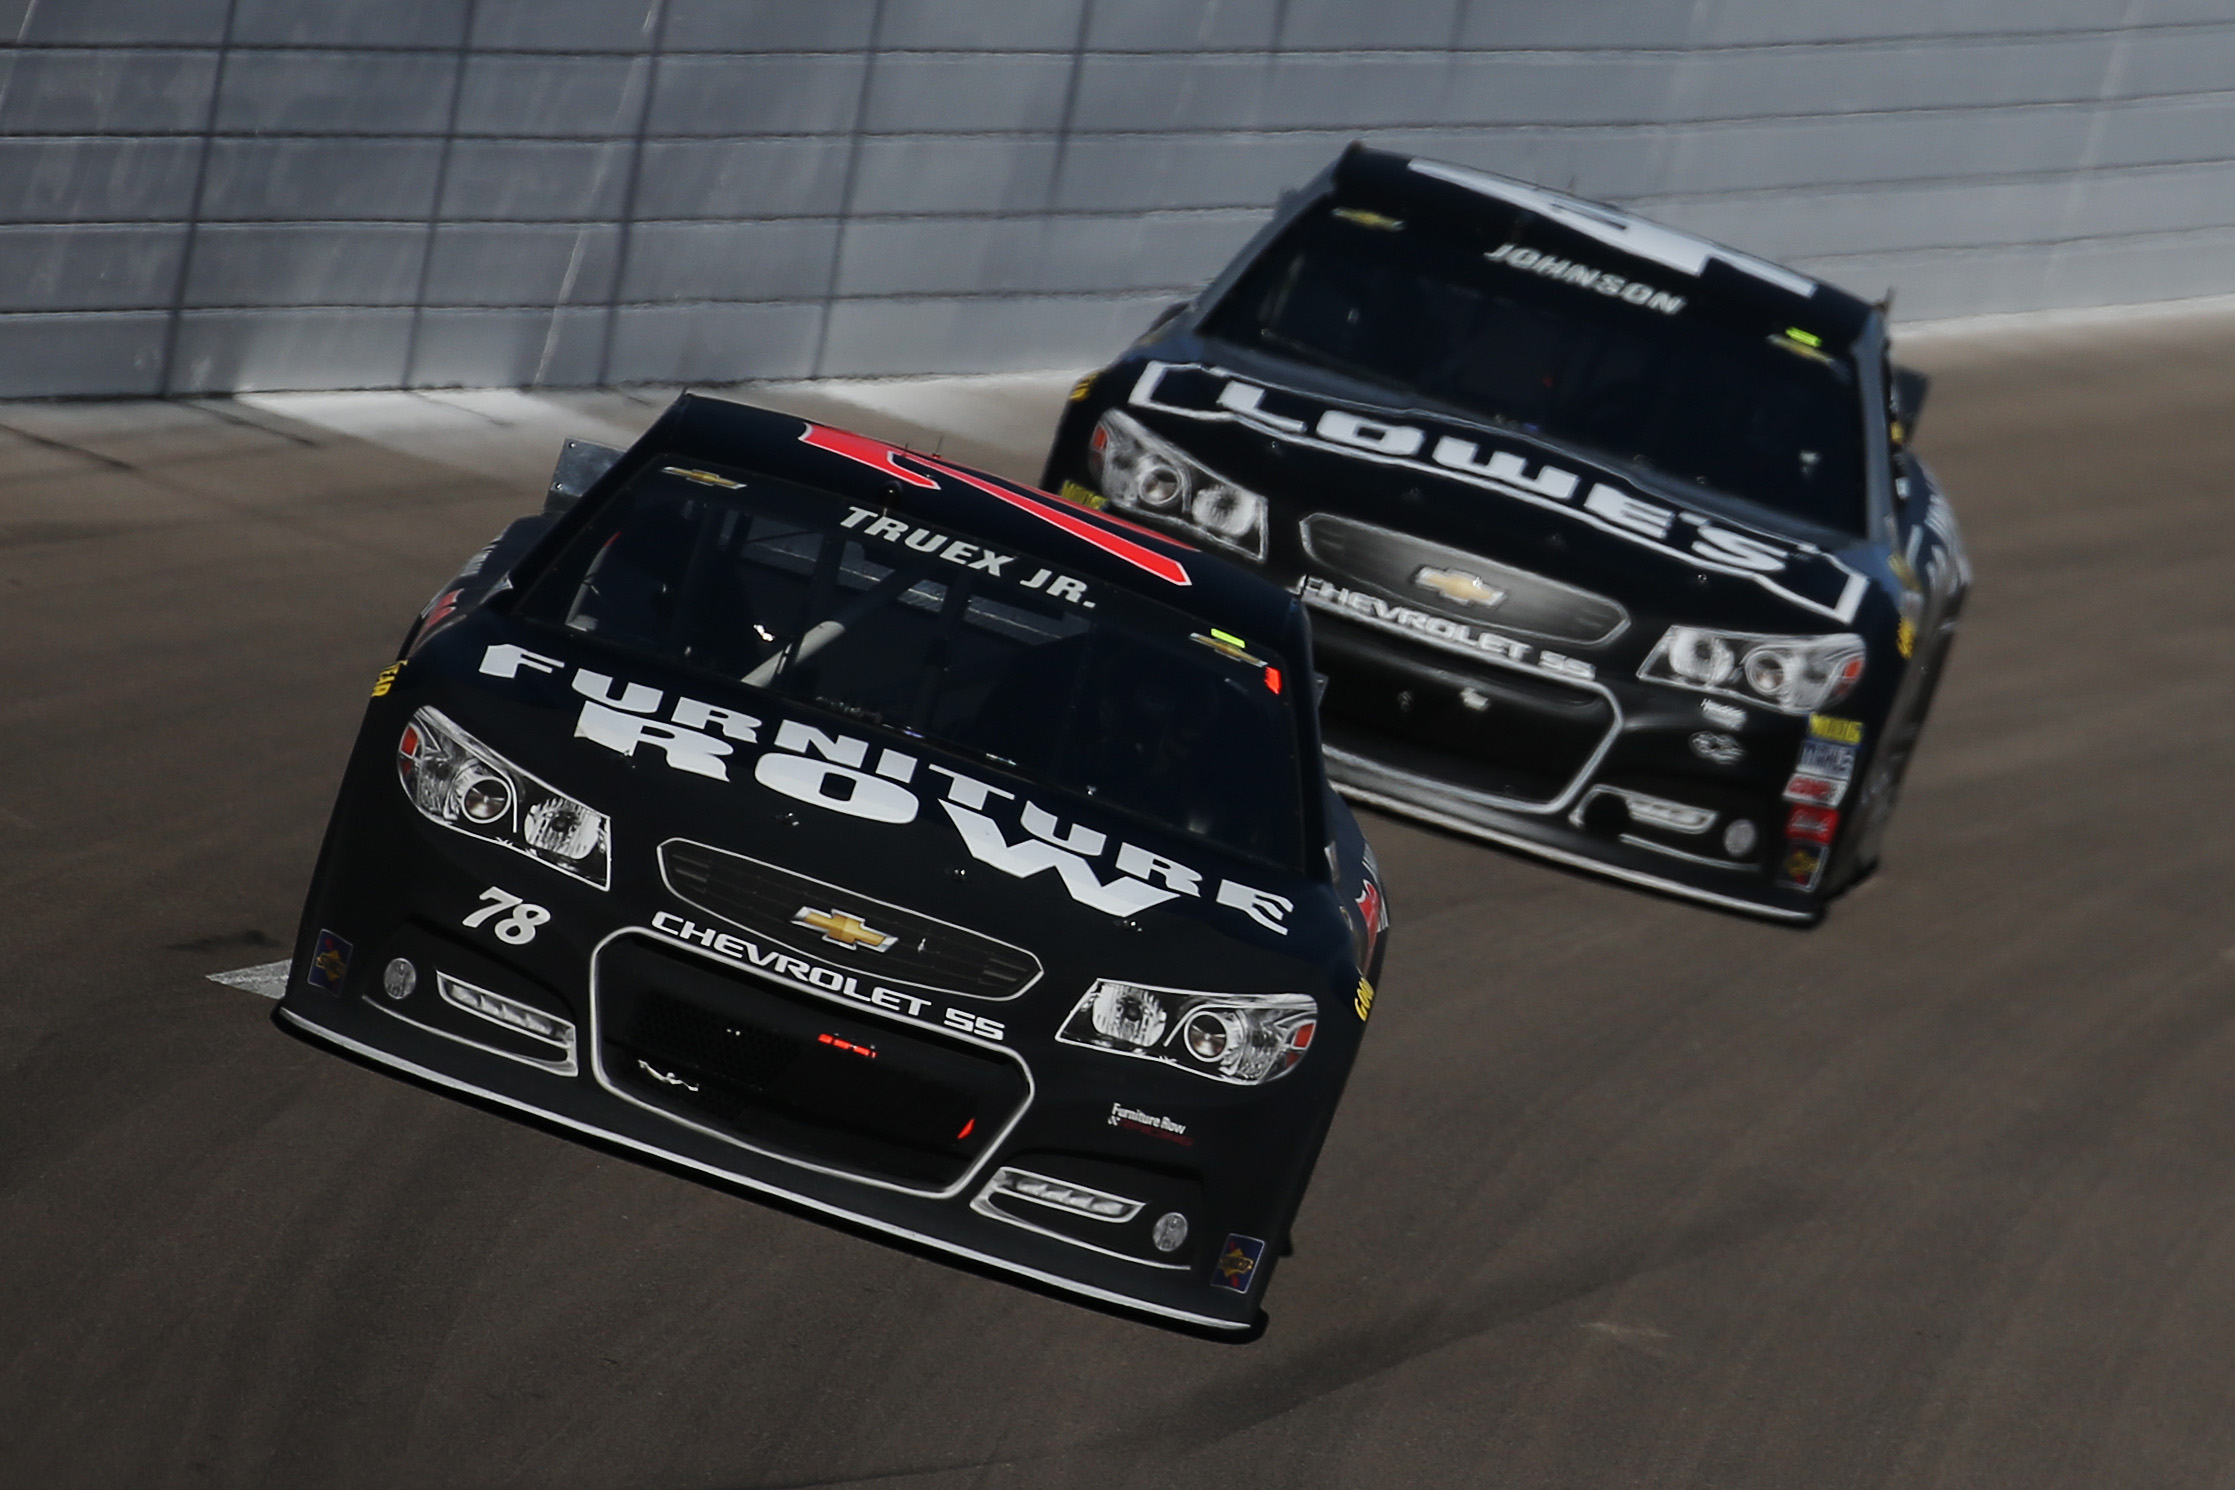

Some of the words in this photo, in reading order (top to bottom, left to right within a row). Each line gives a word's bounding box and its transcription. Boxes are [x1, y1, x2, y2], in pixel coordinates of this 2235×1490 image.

[1485, 244, 1686, 315] JOHNSON
[1217, 381, 1790, 573] LOWE'S
[840, 507, 1016, 578] TRUEX
[1020, 569, 1096, 609] JR.
[1294, 574, 1532, 661] CHEVROLET
[1539, 650, 1596, 681] SS
[480, 643, 1294, 936] FURNITURE
[575, 702, 1179, 917] ROW
[462, 886, 551, 945] 78
[652, 911, 931, 1017] CHEVROLET
[943, 1008, 1005, 1041] SS
